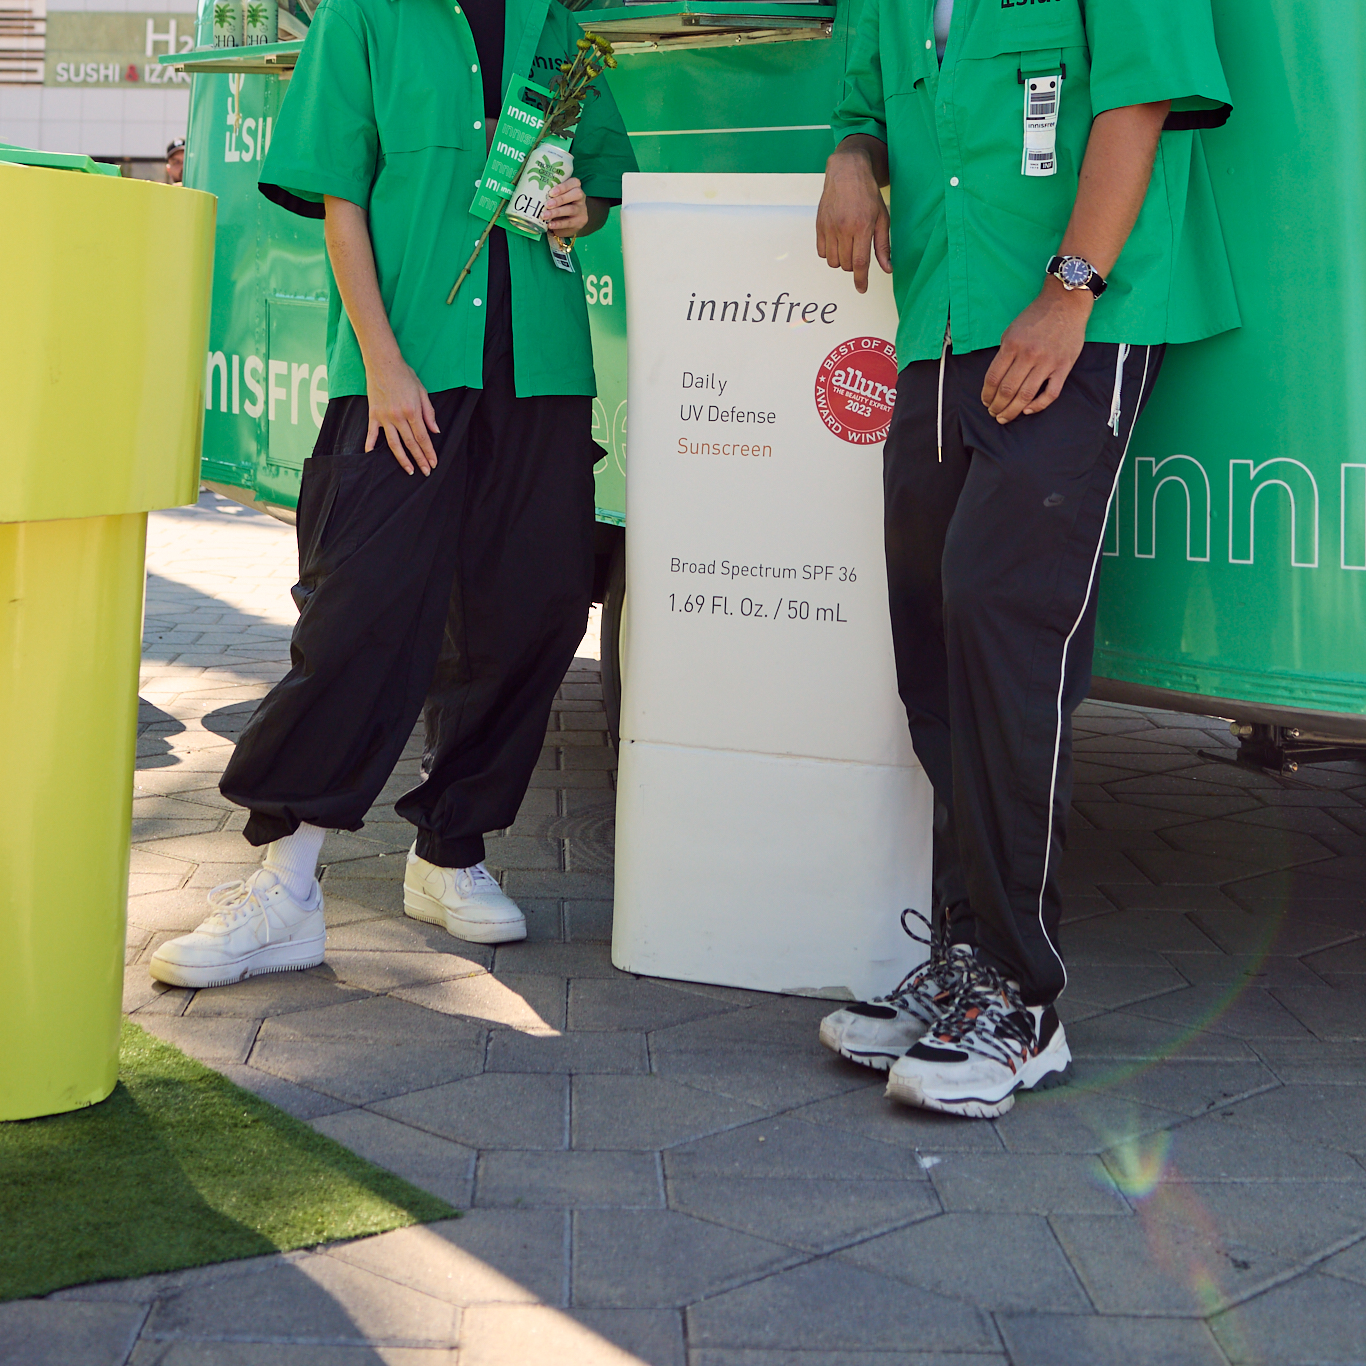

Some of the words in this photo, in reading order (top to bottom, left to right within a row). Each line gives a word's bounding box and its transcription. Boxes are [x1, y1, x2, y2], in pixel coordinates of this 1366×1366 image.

[56, 62, 120, 83] SUSHI
[125, 63, 139, 82] &
[143, 63, 191, 84] IZAK
[515, 193, 545, 218] CH
[686, 292, 838, 324] innisfree
[824, 340, 856, 370] BEST
[861, 339, 881, 349] OF
[682, 372, 728, 396] Daily
[831, 367, 898, 406] allure
[833, 386, 845, 396] THE
[845, 391, 869, 404] BEAUTY
[680, 405, 703, 421] UV
[708, 406, 776, 424] Defense
[816, 385, 842, 434] AWARD
[847, 424, 891, 443] WINN
[845, 400, 872, 418] 2023
[678, 438, 772, 457] Sunscreen
[670, 558, 716, 575] Broad
[721, 560, 797, 580] Spectrum
[802, 565, 834, 581] SPF
[838, 566, 857, 583] 36
[669, 593, 705, 614] 1.69
[711, 596, 733, 616] Fl.
[740, 598, 768, 618] Oz.
[773, 597, 783, 620] /
[788, 600, 809, 621] 50
[816, 603, 848, 622] mL
